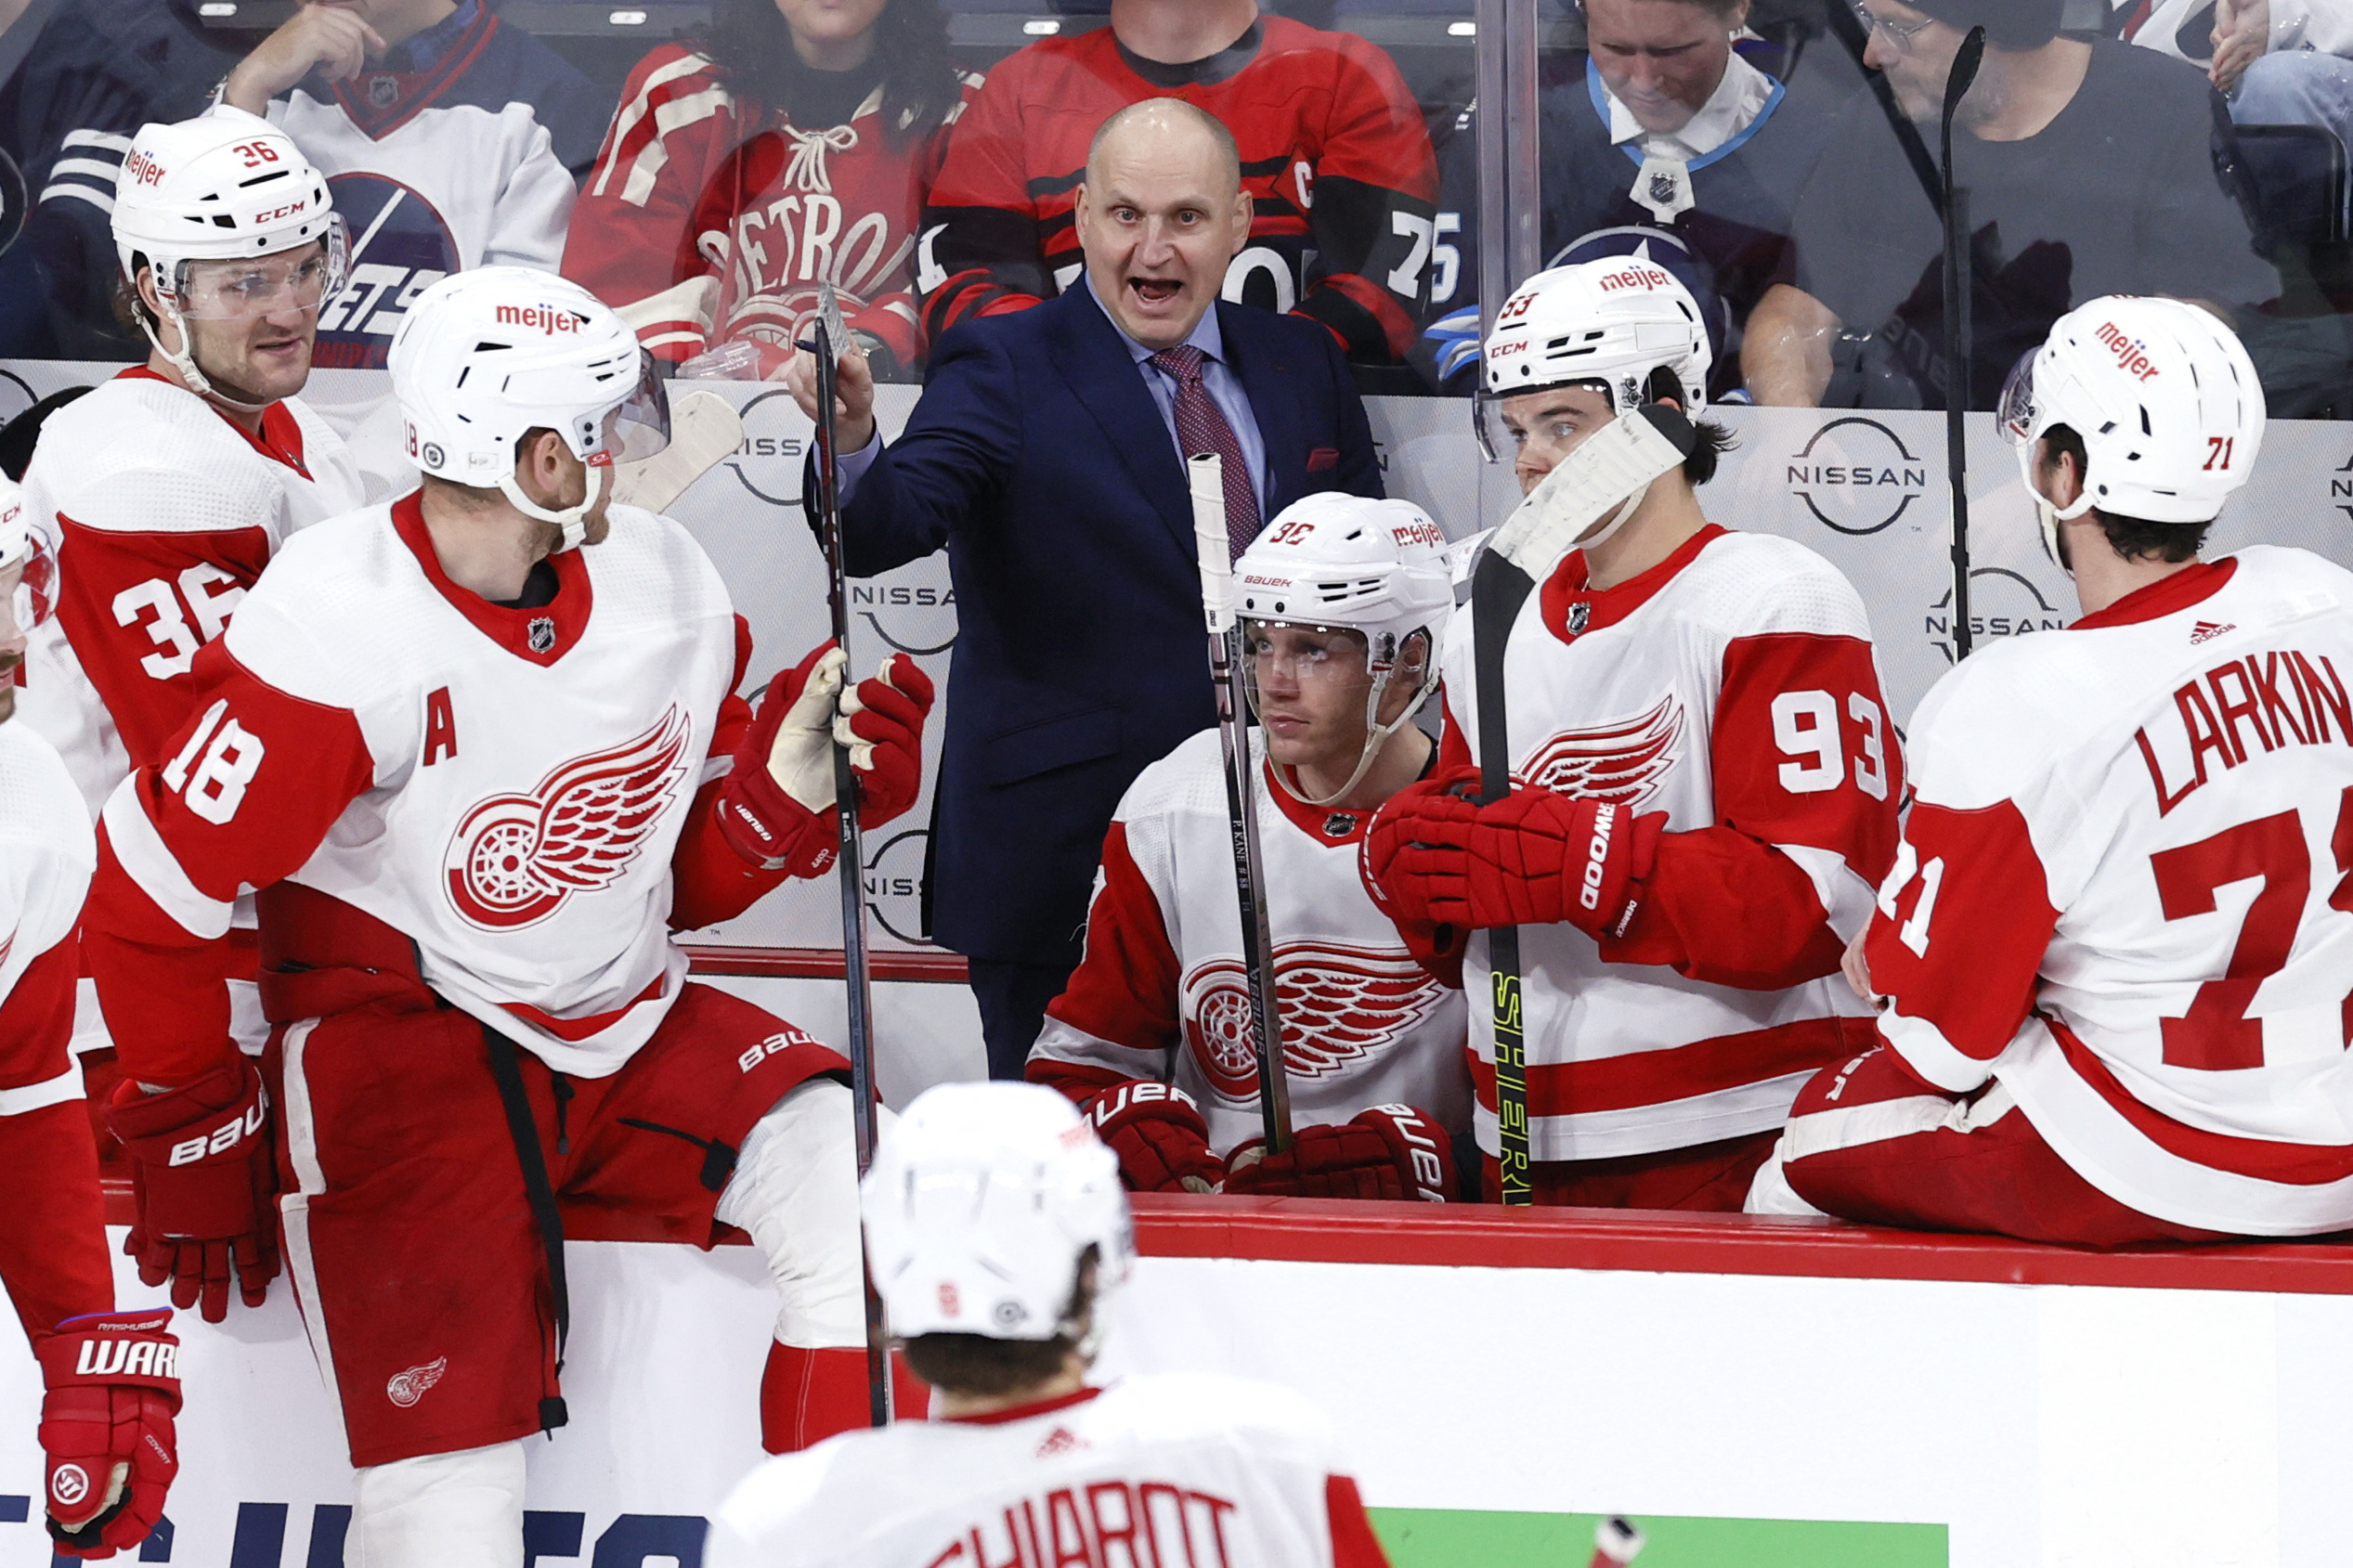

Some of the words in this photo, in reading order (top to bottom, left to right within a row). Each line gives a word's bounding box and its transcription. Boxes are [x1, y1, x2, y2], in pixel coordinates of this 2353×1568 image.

[232, 141, 279, 168] 36
[1294, 161, 1314, 209] C
[254, 200, 306, 224] CCM
[1599, 265, 1671, 292] meijer
[496, 303, 584, 336] meijer
[1490, 340, 1528, 359] CCM
[2094, 320, 2161, 385] meijer
[2202, 435, 2234, 472] 71
[1787, 465, 1926, 487] NISSAN
[111, 561, 251, 680] 36
[1925, 615, 2065, 637] NSSAN
[2190, 623, 2237, 645] adidas
[422, 686, 458, 767] A
[2135, 649, 2353, 819] LARKIN
[162, 698, 266, 825] 18
[1771, 689, 1889, 801] 93
[1234, 831, 1246, 862] KANE
[1876, 837, 1944, 959] 71
[144, 1434, 172, 1465] COVERT
